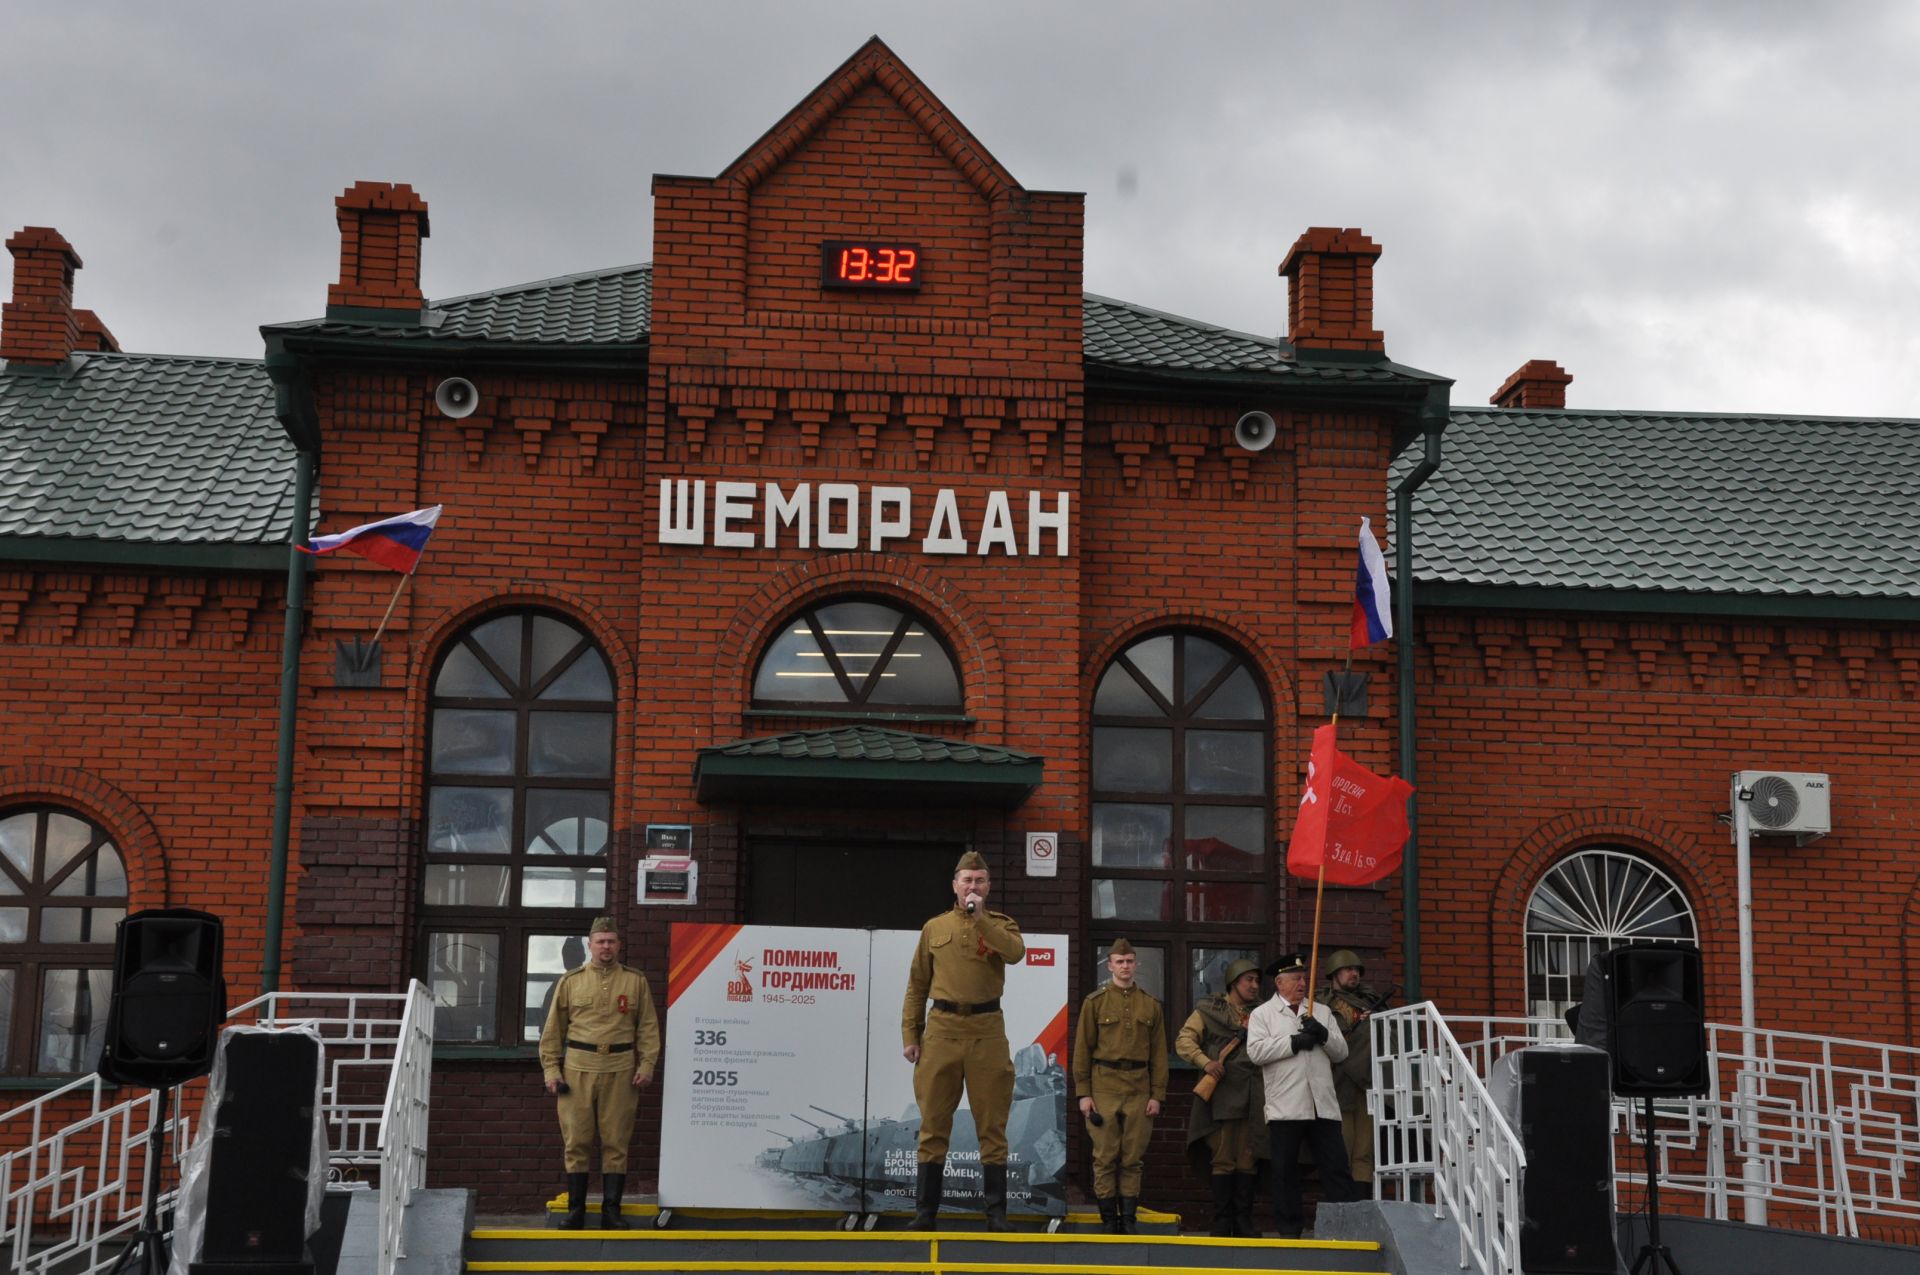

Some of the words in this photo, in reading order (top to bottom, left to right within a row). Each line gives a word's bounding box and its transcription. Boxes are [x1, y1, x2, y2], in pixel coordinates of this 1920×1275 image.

[840, 249, 915, 282] 13:32
[658, 479, 1069, 556] ШЕМОРДАН
[763, 949, 842, 971] ПОМНИМ,
[728, 981, 741, 993] 80
[762, 971, 856, 991] ГОРДИМСЯ!
[694, 1030, 727, 1046] 336
[692, 1070, 738, 1086] 2055
[885, 1148, 903, 1159] 1-Й
[884, 1189, 908, 1197] ФОТО:
